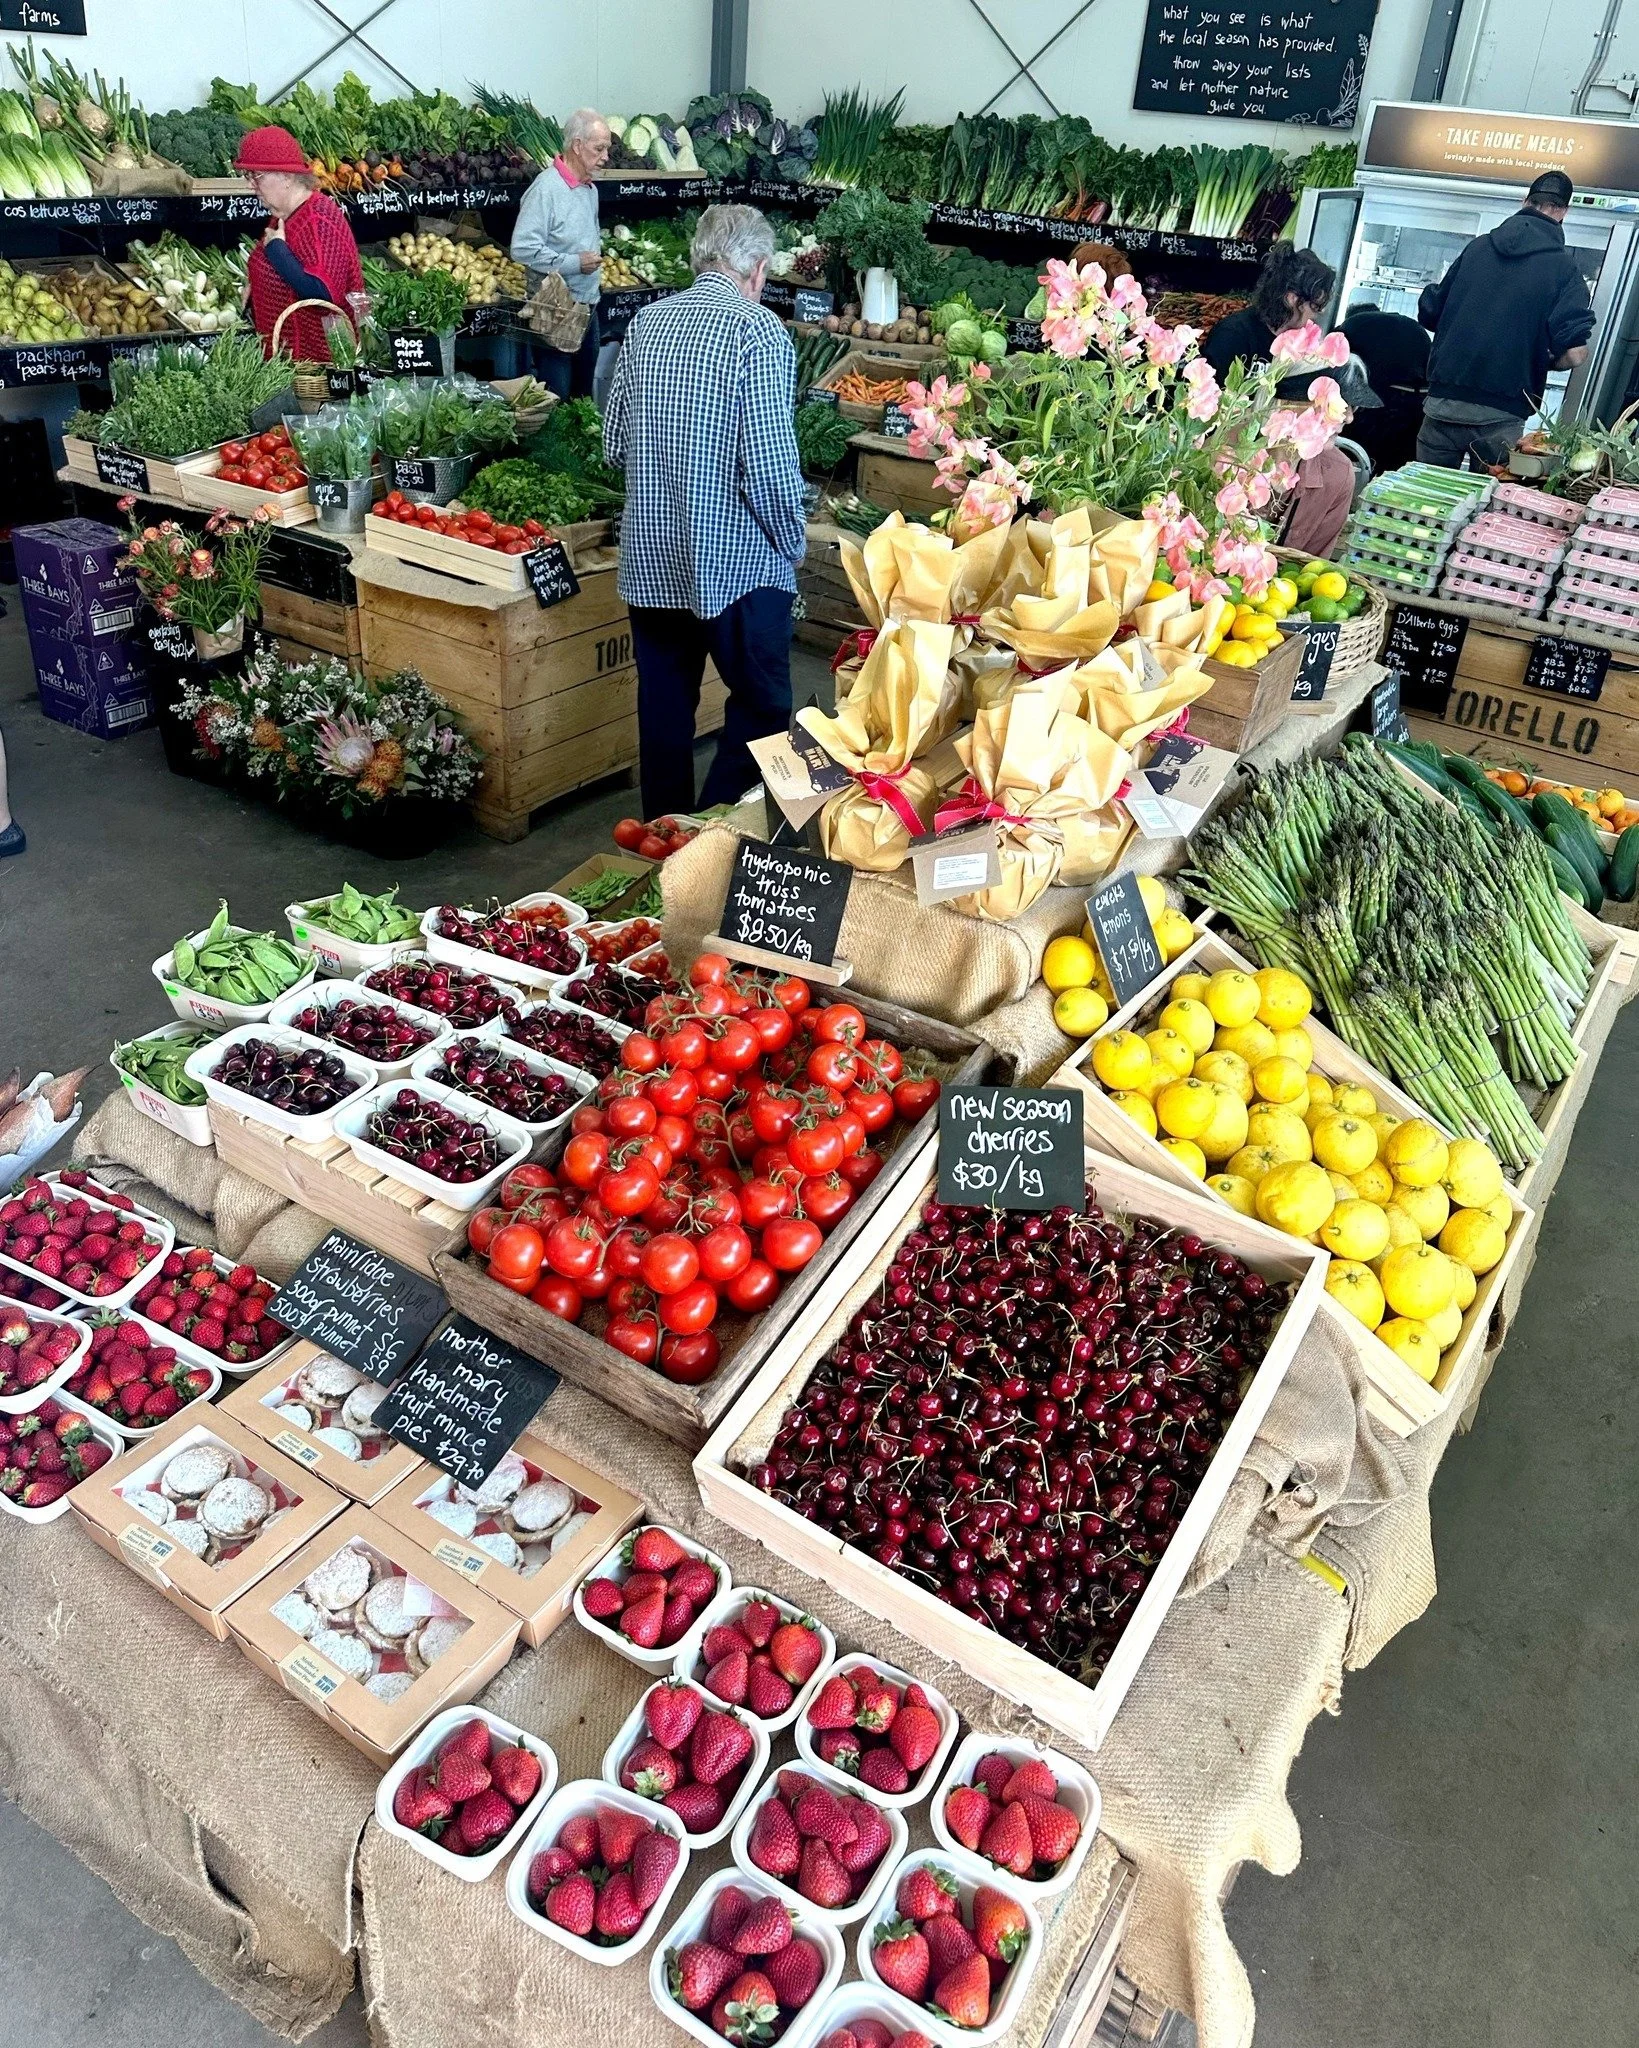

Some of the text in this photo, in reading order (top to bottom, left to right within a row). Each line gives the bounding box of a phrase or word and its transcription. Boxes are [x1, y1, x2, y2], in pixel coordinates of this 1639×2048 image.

[19, 2, 61, 27] farms
[1163, 5, 1314, 31] what you see is what
[1159, 28, 1338, 59] the local season has provided.
[1173, 55, 1311, 80] throw away your lists
[1150, 77, 1290, 99] and let mother nature
[1207, 99, 1236, 114] guide
[1446, 127, 1576, 156] TAKE HOME MEALS
[1444, 152, 1566, 171] lovingly made with local produce
[4, 205, 27, 218] cos
[29, 203, 71, 219] lettuce
[200, 196, 224, 211] baby
[408, 193, 424, 207] red
[426, 190, 460, 206] beetroot
[993, 212, 1023, 223] organic
[1023, 215, 1044, 232] curly
[1160, 233, 1186, 247] leeks
[1216, 240, 1258, 254] rhubarb
[394, 336, 423, 350] choc
[397, 348, 424, 358] mint
[16, 346, 86, 370] packham
[397, 359, 411, 369] $3
[21, 363, 57, 381] pears
[395, 460, 423, 476] basil
[315, 483, 335, 494] mint
[533, 561, 551, 576] roma
[22, 576, 46, 595] THREE
[47, 585, 70, 602] BAYS
[98, 580, 118, 590] THREE
[118, 575, 136, 586] BAYS
[1396, 612, 1459, 638] D'Alberto eggs
[39, 669, 62, 688] THREE
[64, 678, 86, 697] BAYS
[113, 673, 132, 685] THREE
[1540, 676, 1555, 687] $15
[741, 845, 832, 886] hydroponic
[756, 874, 801, 900] truss
[1095, 883, 1126, 912] eureka
[734, 885, 817, 922] tomatoes
[1098, 907, 1132, 943] lemons
[950, 1090, 1072, 1124] new season
[967, 1120, 1054, 1155] cherries
[322, 1234, 395, 1287] mainridge
[306, 1257, 404, 1326] strawberries
[322, 1305, 377, 1343] punnet
[373, 1327, 405, 1360] $6
[311, 1322, 359, 1357] punnet
[362, 1350, 390, 1378] $9
[439, 1326, 512, 1370] mother
[409, 1358, 503, 1434] handmade
[452, 1362, 510, 1411] mary
[388, 1414, 432, 1444] pies
[390, 1382, 487, 1456] fruit mince
